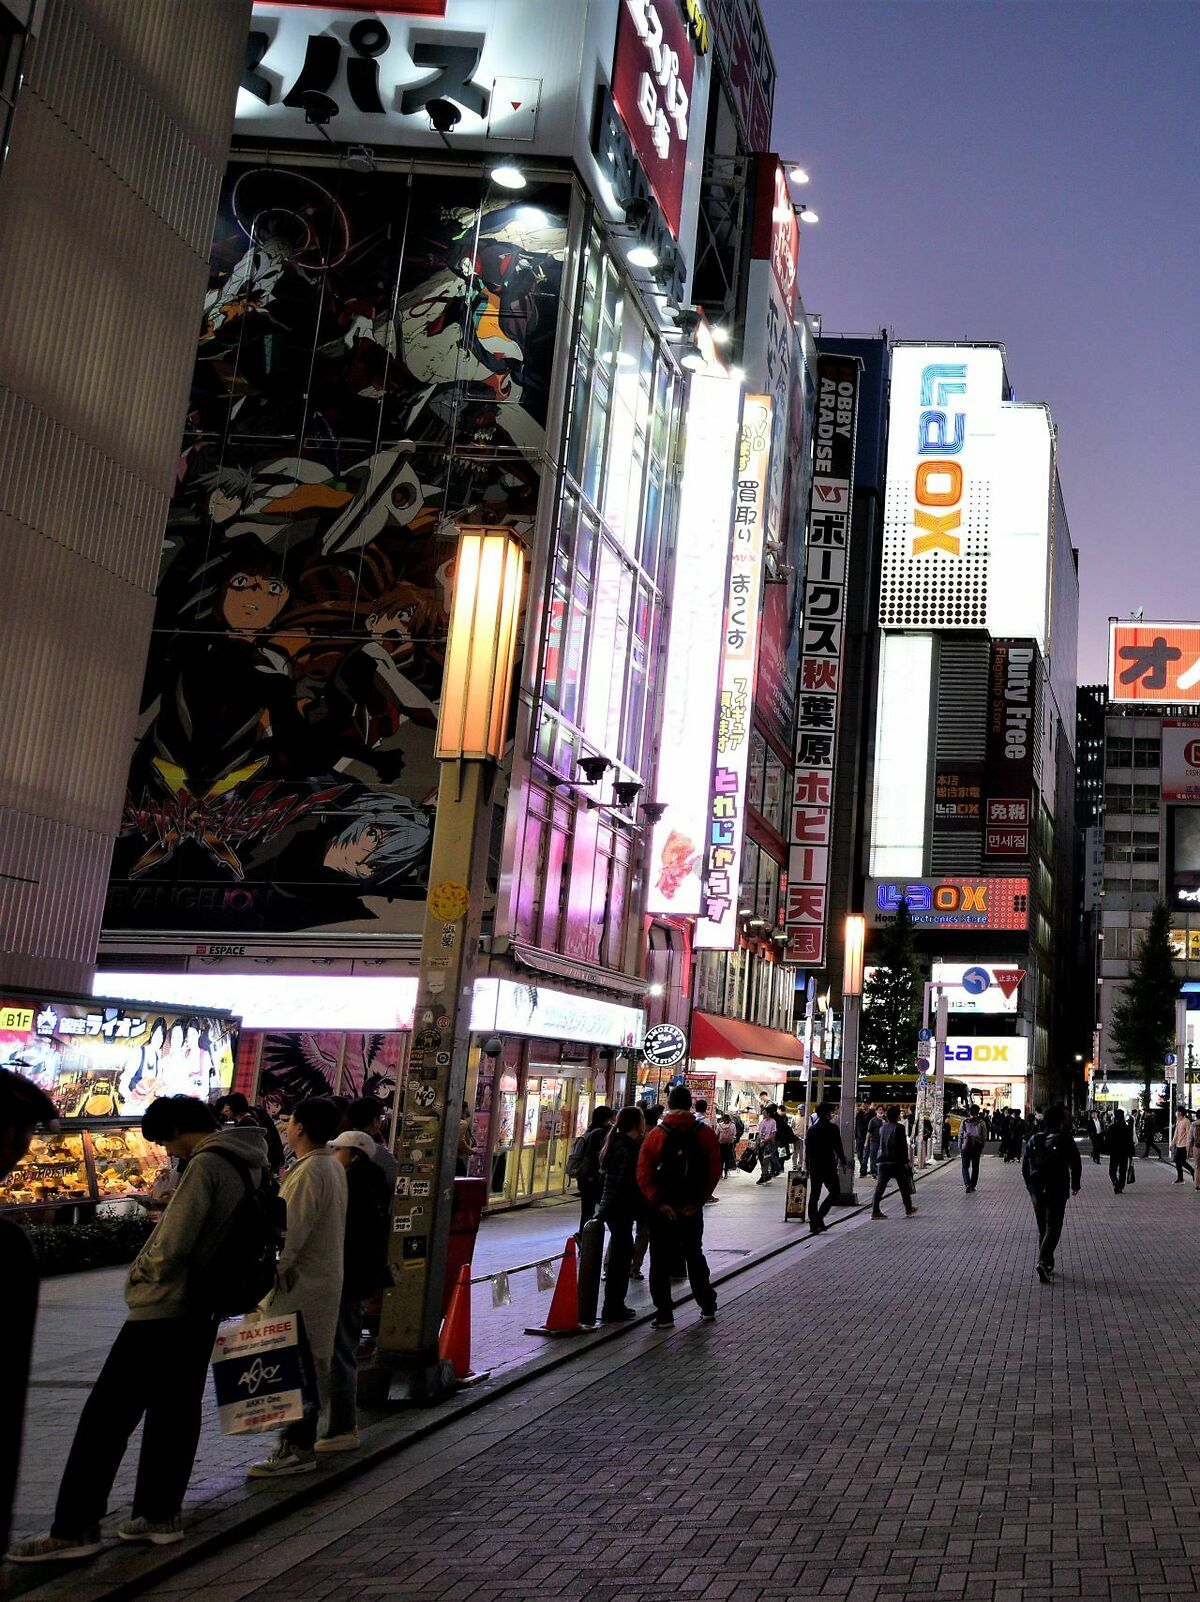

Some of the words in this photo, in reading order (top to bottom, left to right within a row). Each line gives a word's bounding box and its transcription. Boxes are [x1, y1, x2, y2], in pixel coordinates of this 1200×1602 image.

[834, 364, 857, 440] HOBBY
[815, 364, 837, 473] PARADISE
[735, 480, 760, 543] 買取り
[727, 574, 751, 650] まっくす
[1004, 648, 1034, 702] Duty
[1004, 707, 1032, 759] Free
[990, 803, 1026, 820] 免税
[706, 766, 738, 924] とれじゃらす
[988, 835, 1026, 848] 면세점
[874, 914, 900, 923] Hom
[911, 914, 958, 924] lectronics
[962, 915, 987, 924] Store
[209, 945, 245, 955] ESPACE
[998, 974, 1019, 983] 止まれ
[7, 1012, 32, 1027] B1F
[59, 1014, 147, 1038] 銀座ライオン
[240, 1330, 262, 1341] TAX
[263, 1321, 292, 1336] FREE
